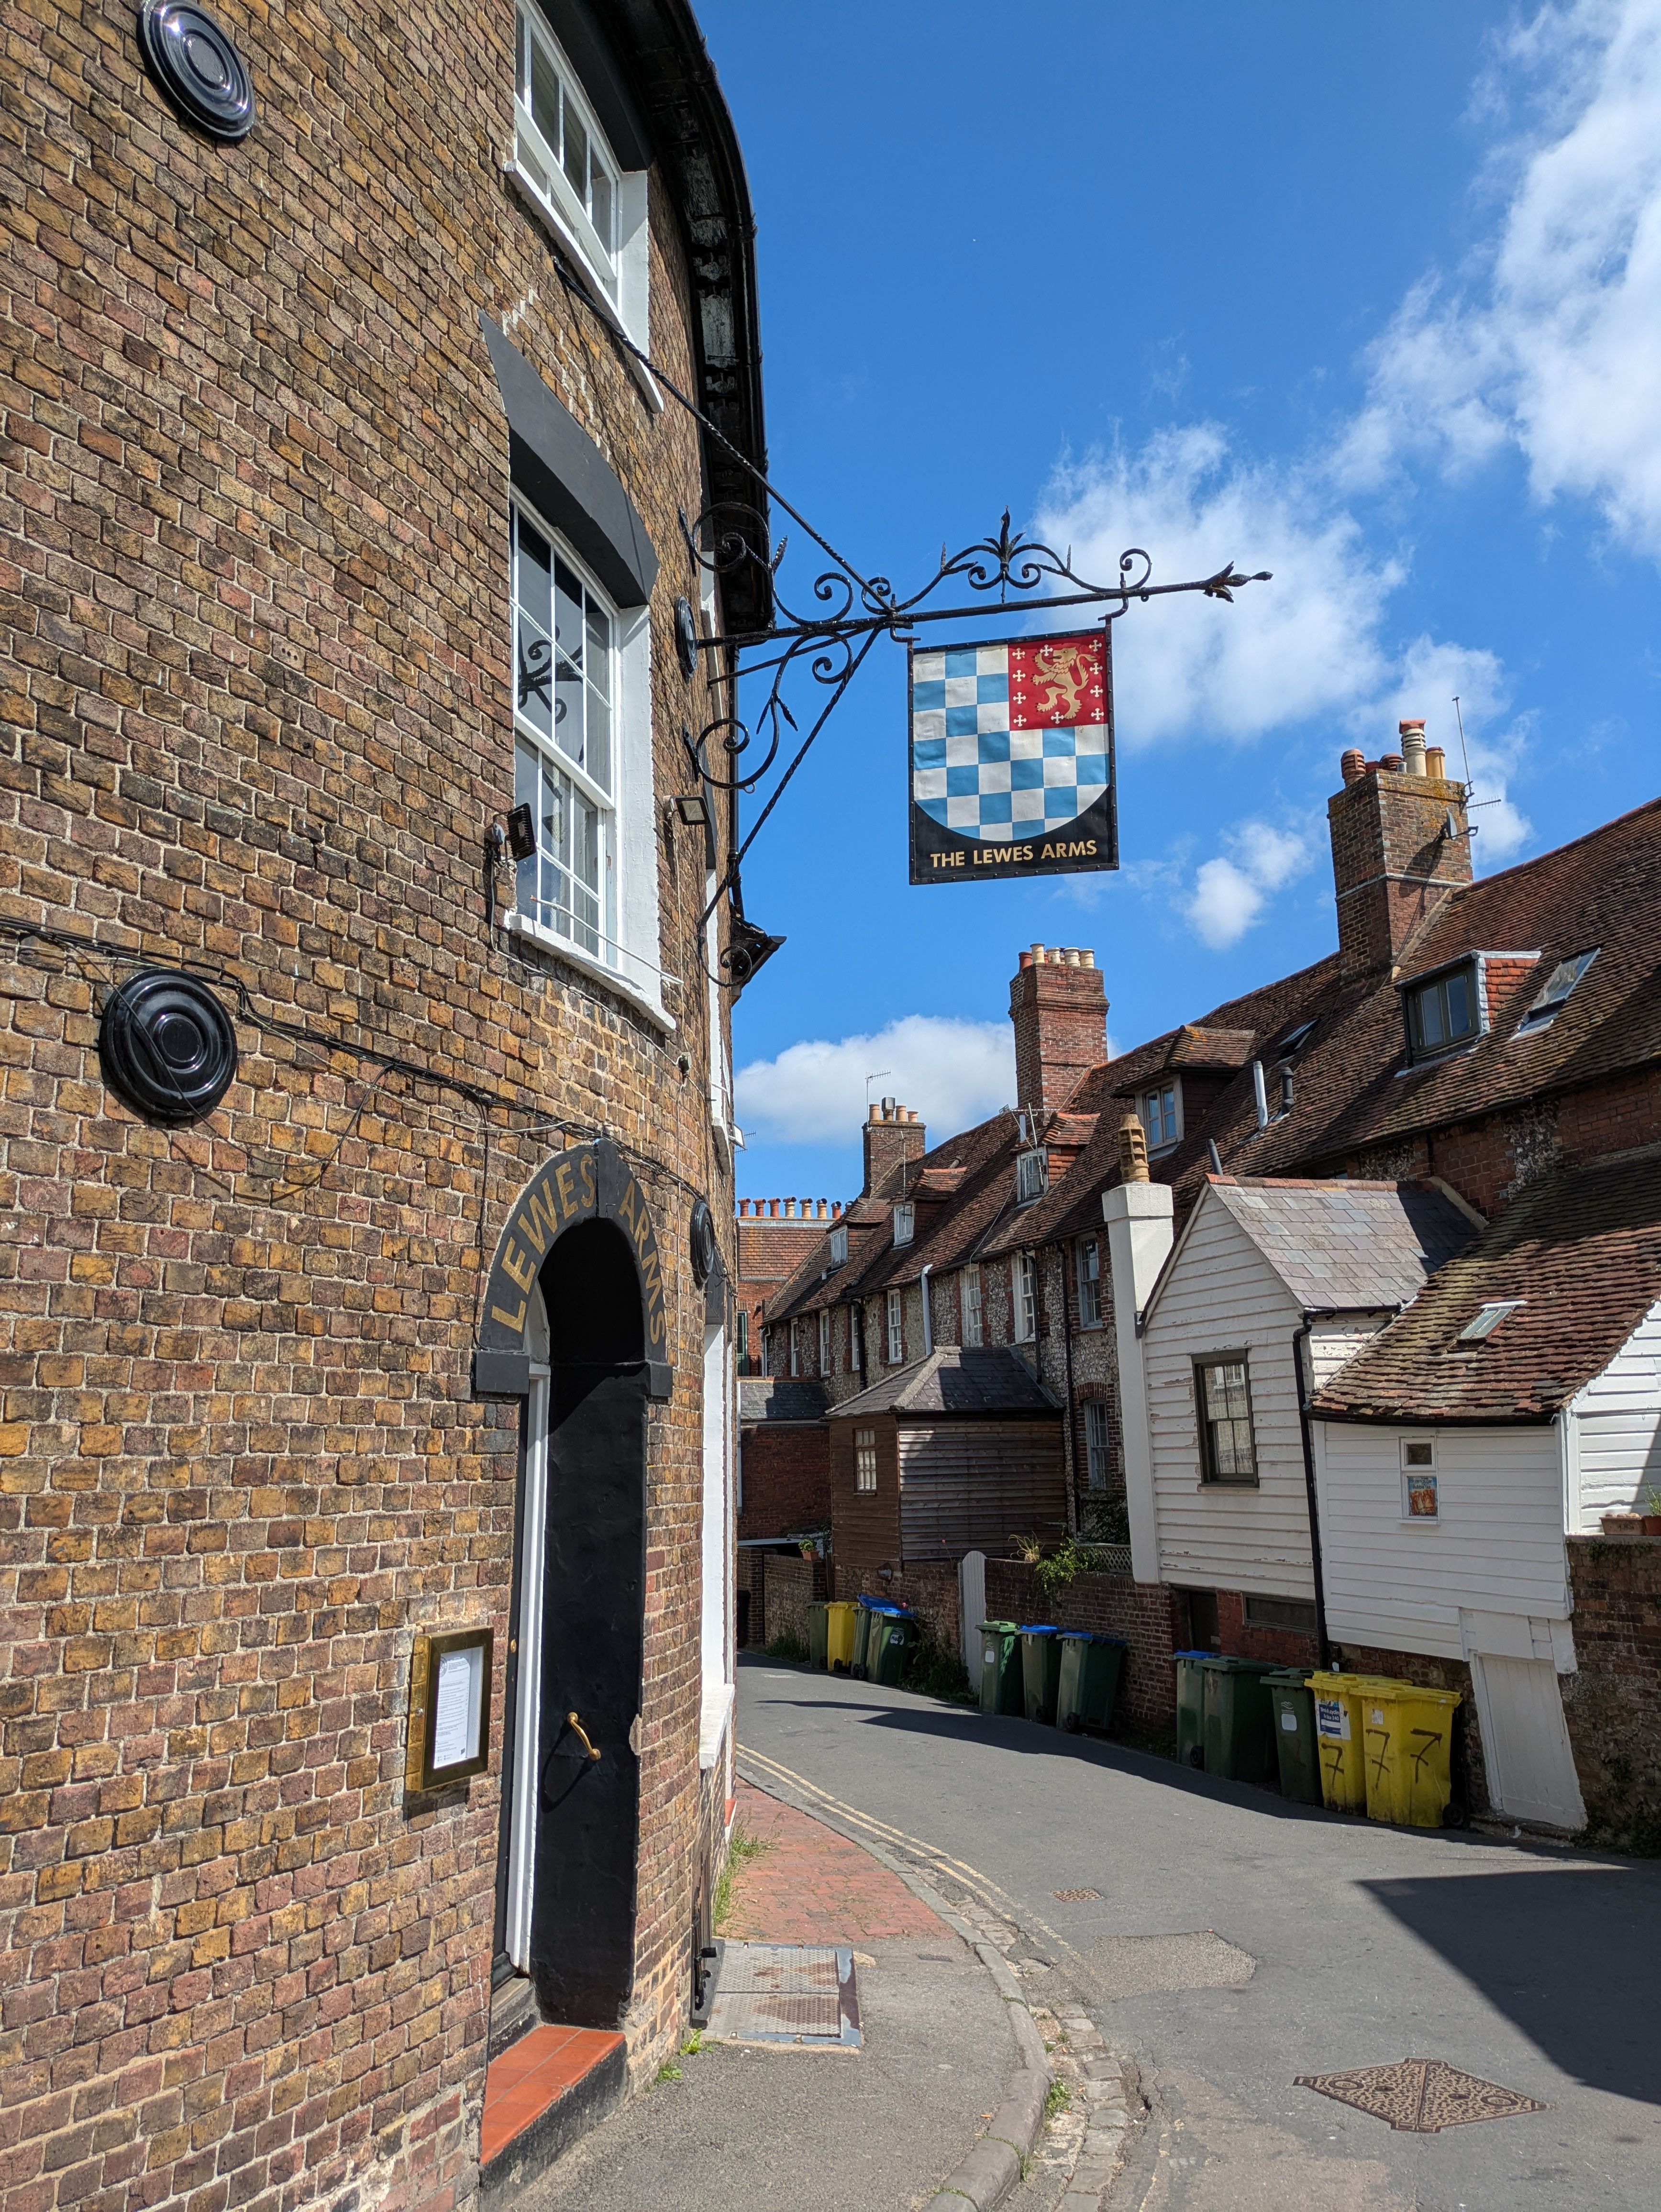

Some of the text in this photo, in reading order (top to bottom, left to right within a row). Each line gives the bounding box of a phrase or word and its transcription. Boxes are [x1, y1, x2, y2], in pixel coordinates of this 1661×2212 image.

[930, 840, 1097, 868] THE LEWES ARMS
[491, 1153, 665, 1344] LEWES ARMS
[1321, 1743, 1344, 1786] 7
[1365, 1728, 1391, 1790] 7
[1410, 1728, 1443, 1783] 7
